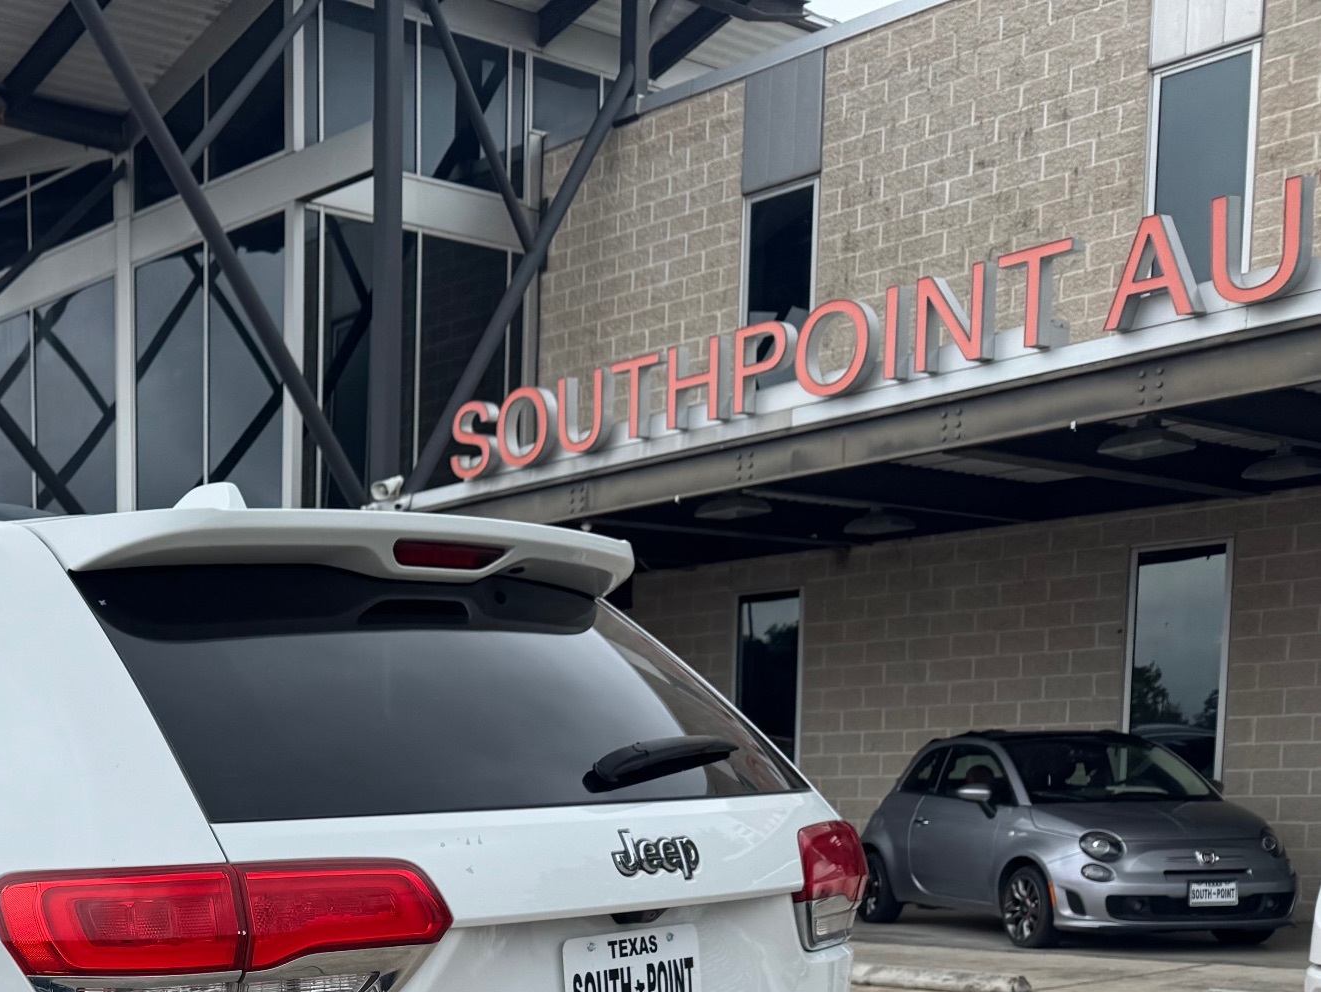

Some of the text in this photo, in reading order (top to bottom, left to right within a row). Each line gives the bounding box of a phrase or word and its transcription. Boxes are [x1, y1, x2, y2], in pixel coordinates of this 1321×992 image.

[450, 170, 1321, 480] SOUTHPOINT AU
[611, 828, 700, 880] Jeep
[607, 935, 658, 959] TEXAS
